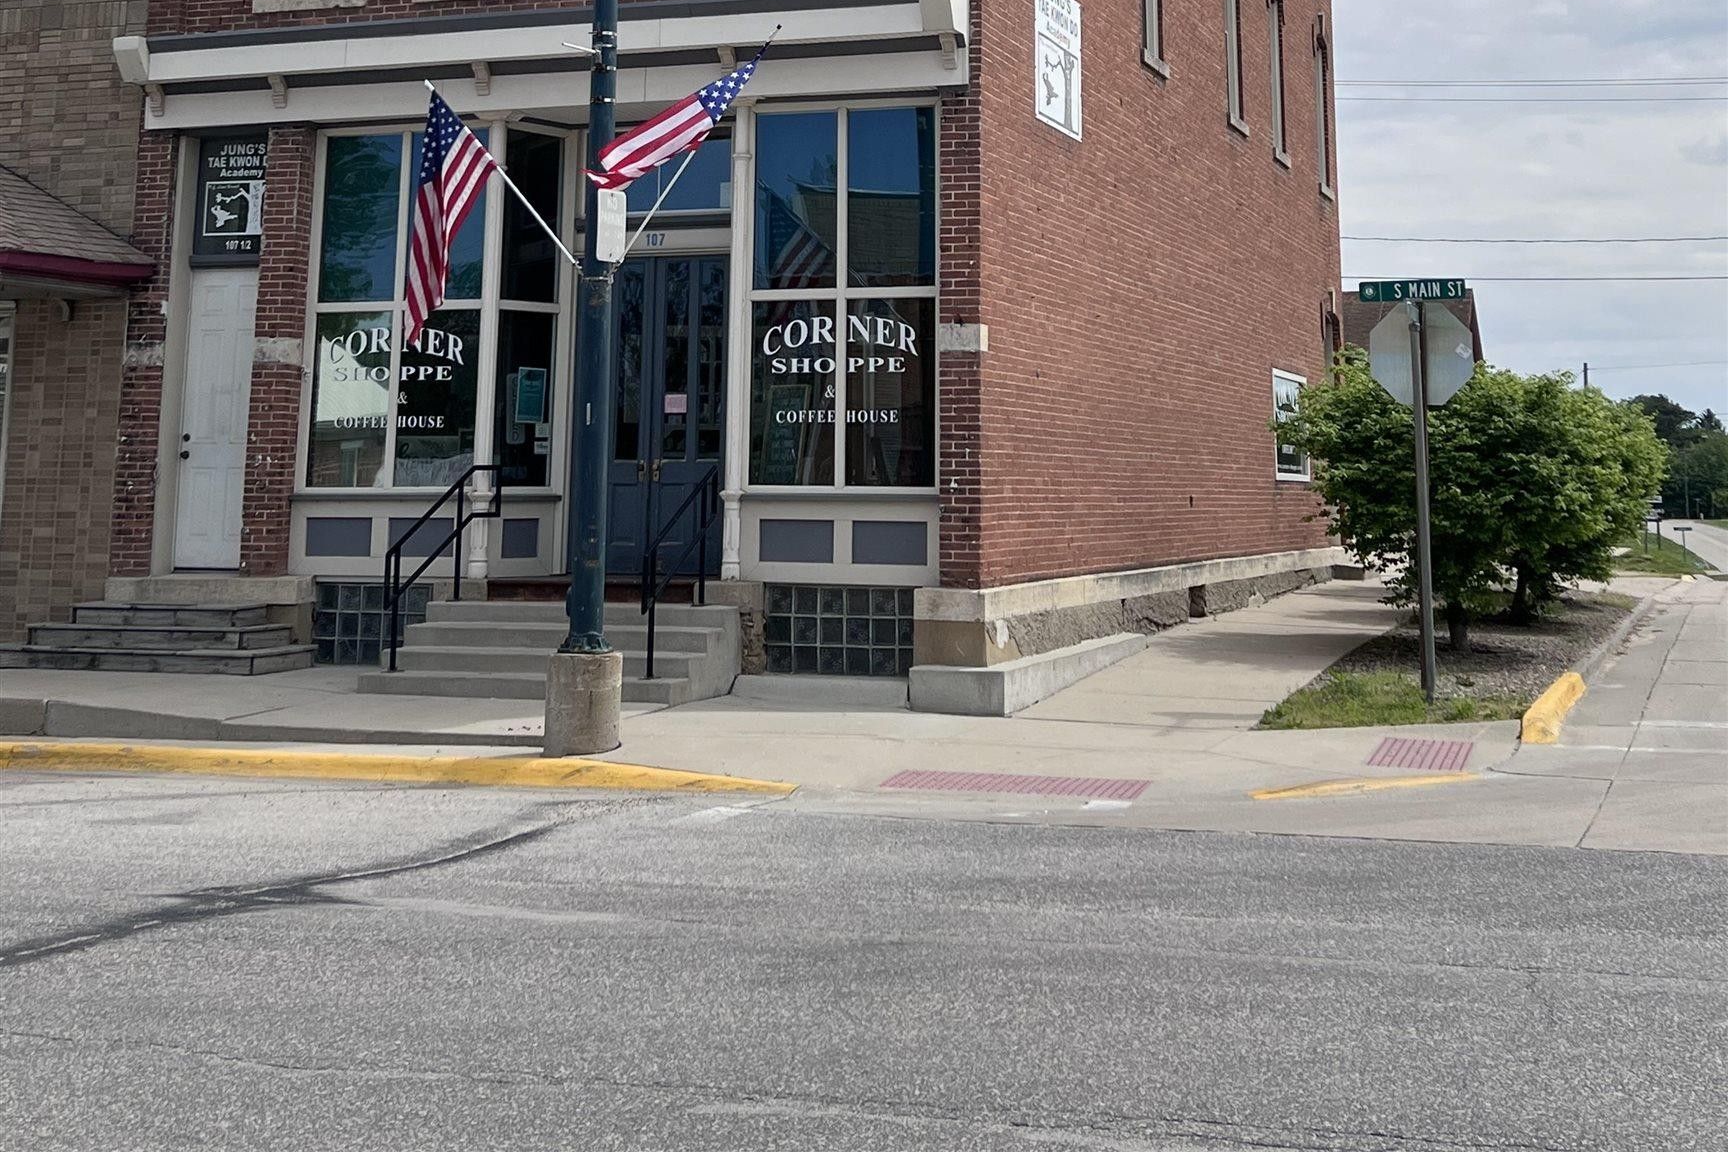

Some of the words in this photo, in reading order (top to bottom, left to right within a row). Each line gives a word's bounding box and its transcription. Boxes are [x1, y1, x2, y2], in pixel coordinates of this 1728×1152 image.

[1051, 5, 1069, 32] KWON
[1070, 19, 1078, 37] DO
[220, 143, 266, 156] JUNG'S
[208, 156, 227, 168] TAE
[229, 155, 260, 168] KWON
[220, 168, 263, 179] Academy
[240, 240, 252, 250] 1/2
[646, 233, 665, 246] 107
[1394, 283, 1402, 298] S
[1408, 282, 1441, 298] MAIN
[1447, 281, 1463, 296] ST
[763, 315, 919, 356] CORNER
[771, 357, 906, 374] SHOPPE
[334, 365, 453, 382] SHOPPE
[397, 391, 408, 405] &
[824, 384, 835, 398] &
[334, 415, 387, 428] COFFEE
[397, 415, 445, 428] HOUSE
[776, 409, 836, 424] COFFEE
[847, 409, 899, 423] HOUSE
